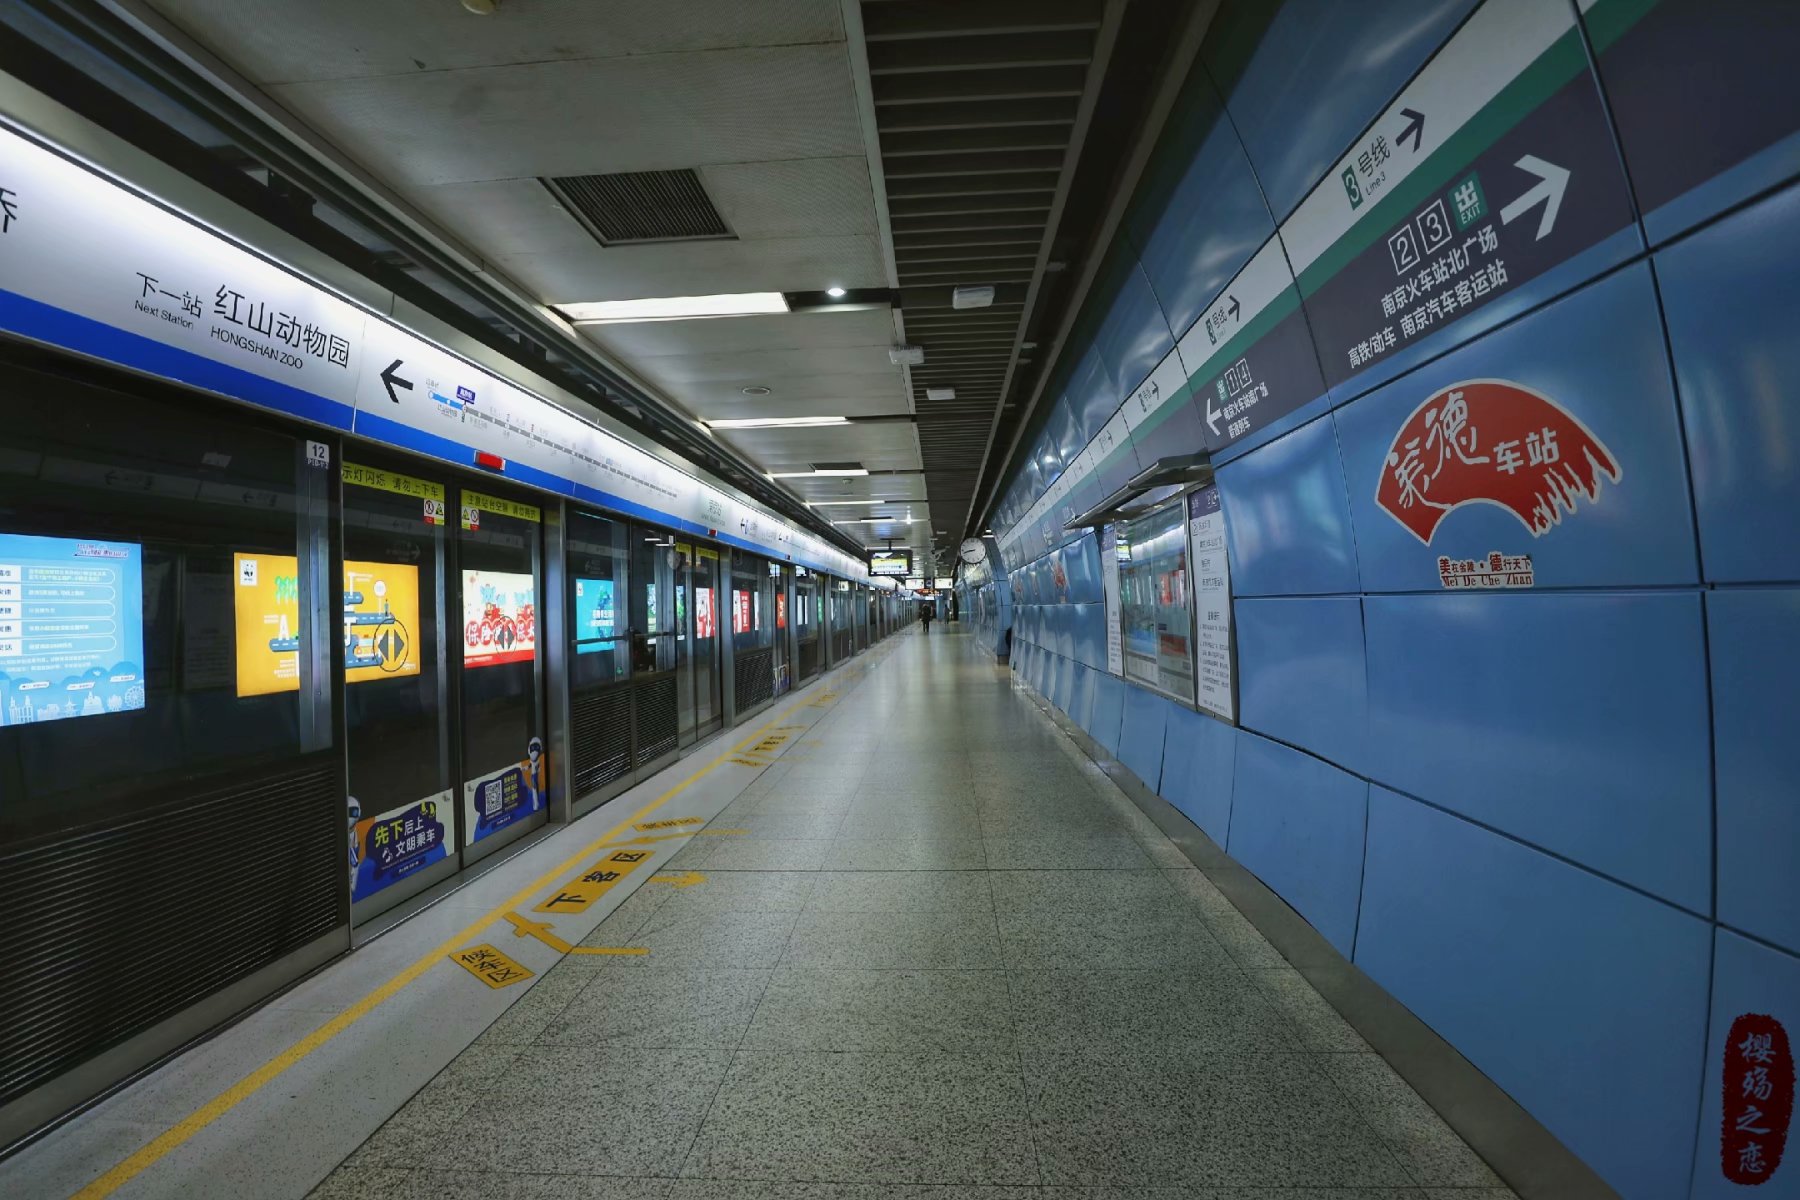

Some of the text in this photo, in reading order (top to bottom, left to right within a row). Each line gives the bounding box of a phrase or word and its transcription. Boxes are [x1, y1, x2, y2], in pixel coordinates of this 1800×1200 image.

[1345, 136, 1391, 203] 3 号线
[1366, 177, 1382, 195] Line
[1454, 180, 1478, 213] 出
[1460, 202, 1481, 225] EXIT
[1380, 224, 1499, 318] 南京火车站北广场
[134, 300, 195, 331] Next Station
[136, 272, 349, 369] 下一站 红山动物园
[1347, 258, 1508, 369] 高铁/动车 南京汽车客运站
[210, 325, 304, 370] HONGSHAN ZOO
[312, 444, 325, 459] 12
[1463, 575, 1476, 587] De
[374, 816, 425, 848] 先下后上
[395, 828, 436, 858] 文明乘车
[546, 851, 646, 909] 下客区
